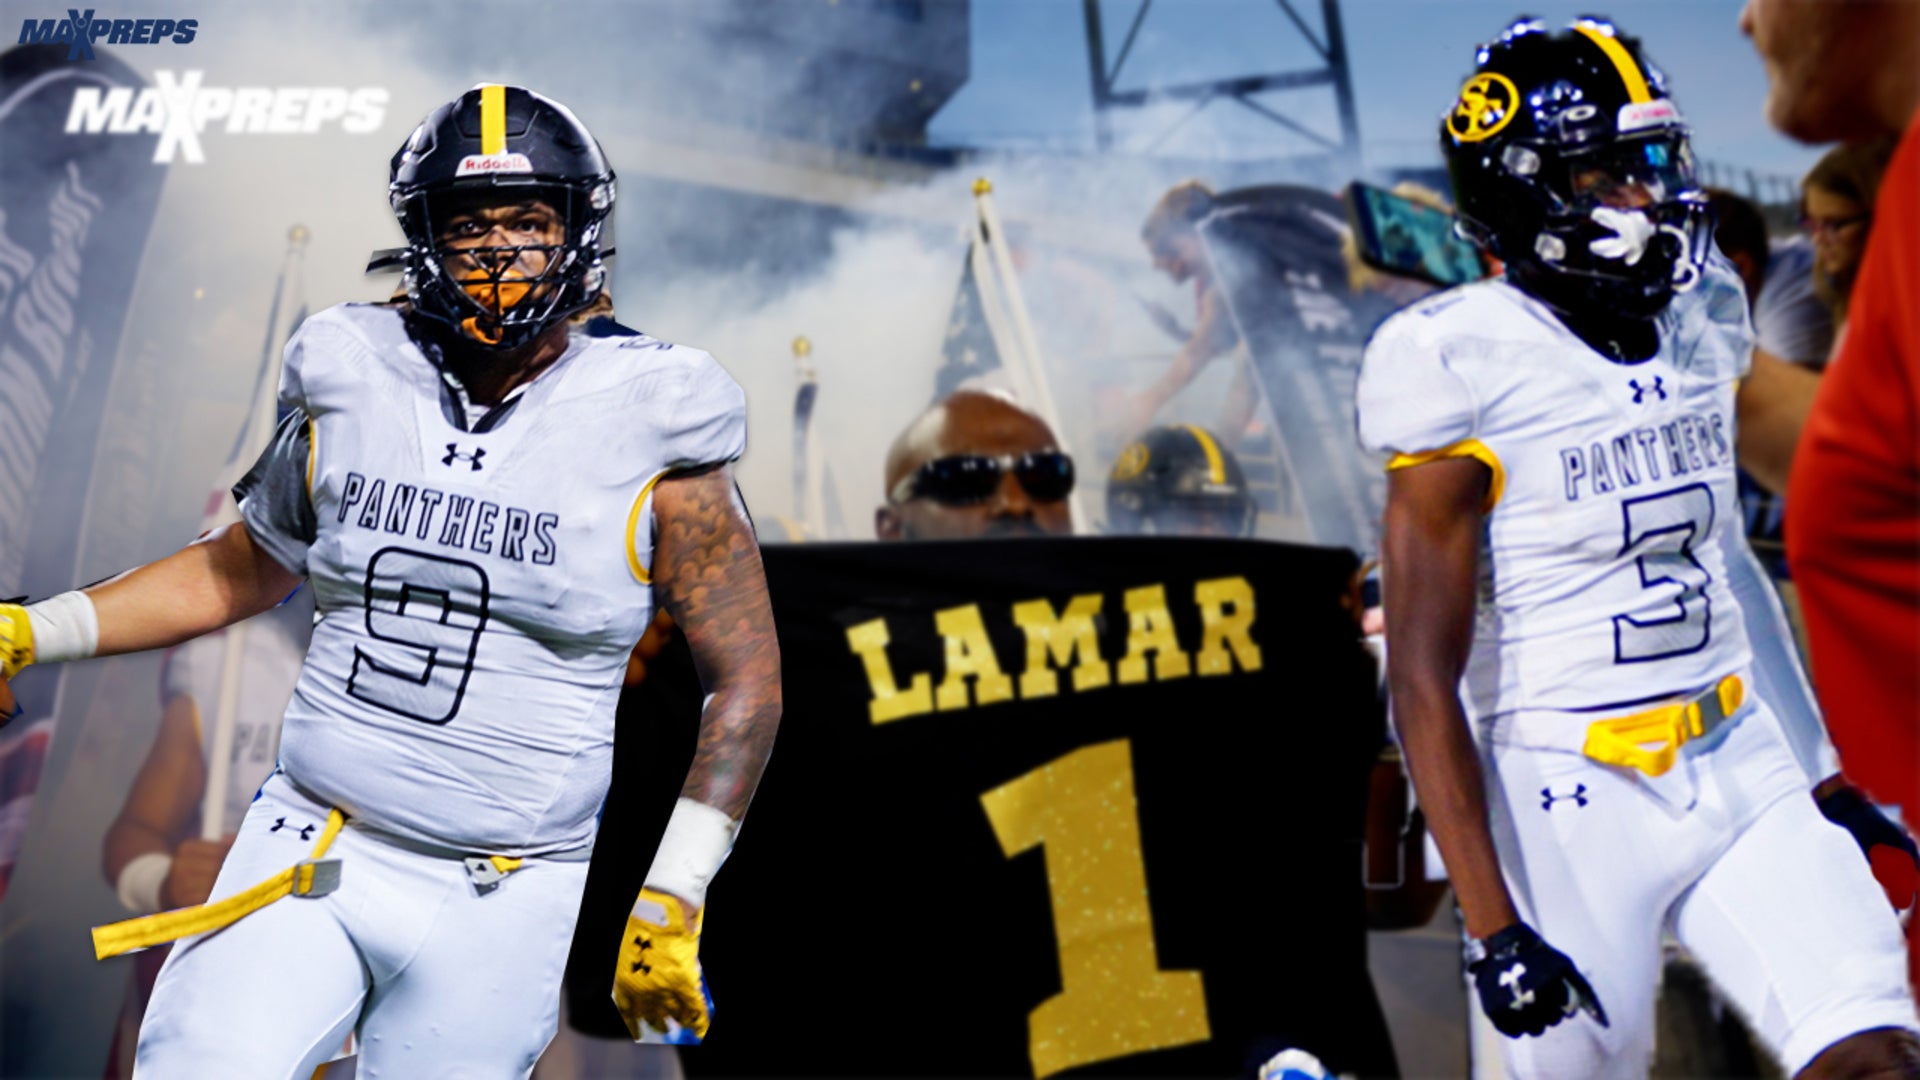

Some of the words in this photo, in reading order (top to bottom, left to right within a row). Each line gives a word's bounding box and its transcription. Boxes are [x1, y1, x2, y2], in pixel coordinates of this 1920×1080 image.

[338, 472, 558, 565] PANTHERS
[1560, 412, 1730, 501] PANTHERS
[346, 546, 490, 726] 9
[846, 575, 1262, 725] LAMAR
[1611, 482, 1715, 665] 3
[980, 737, 1211, 1080] 1
